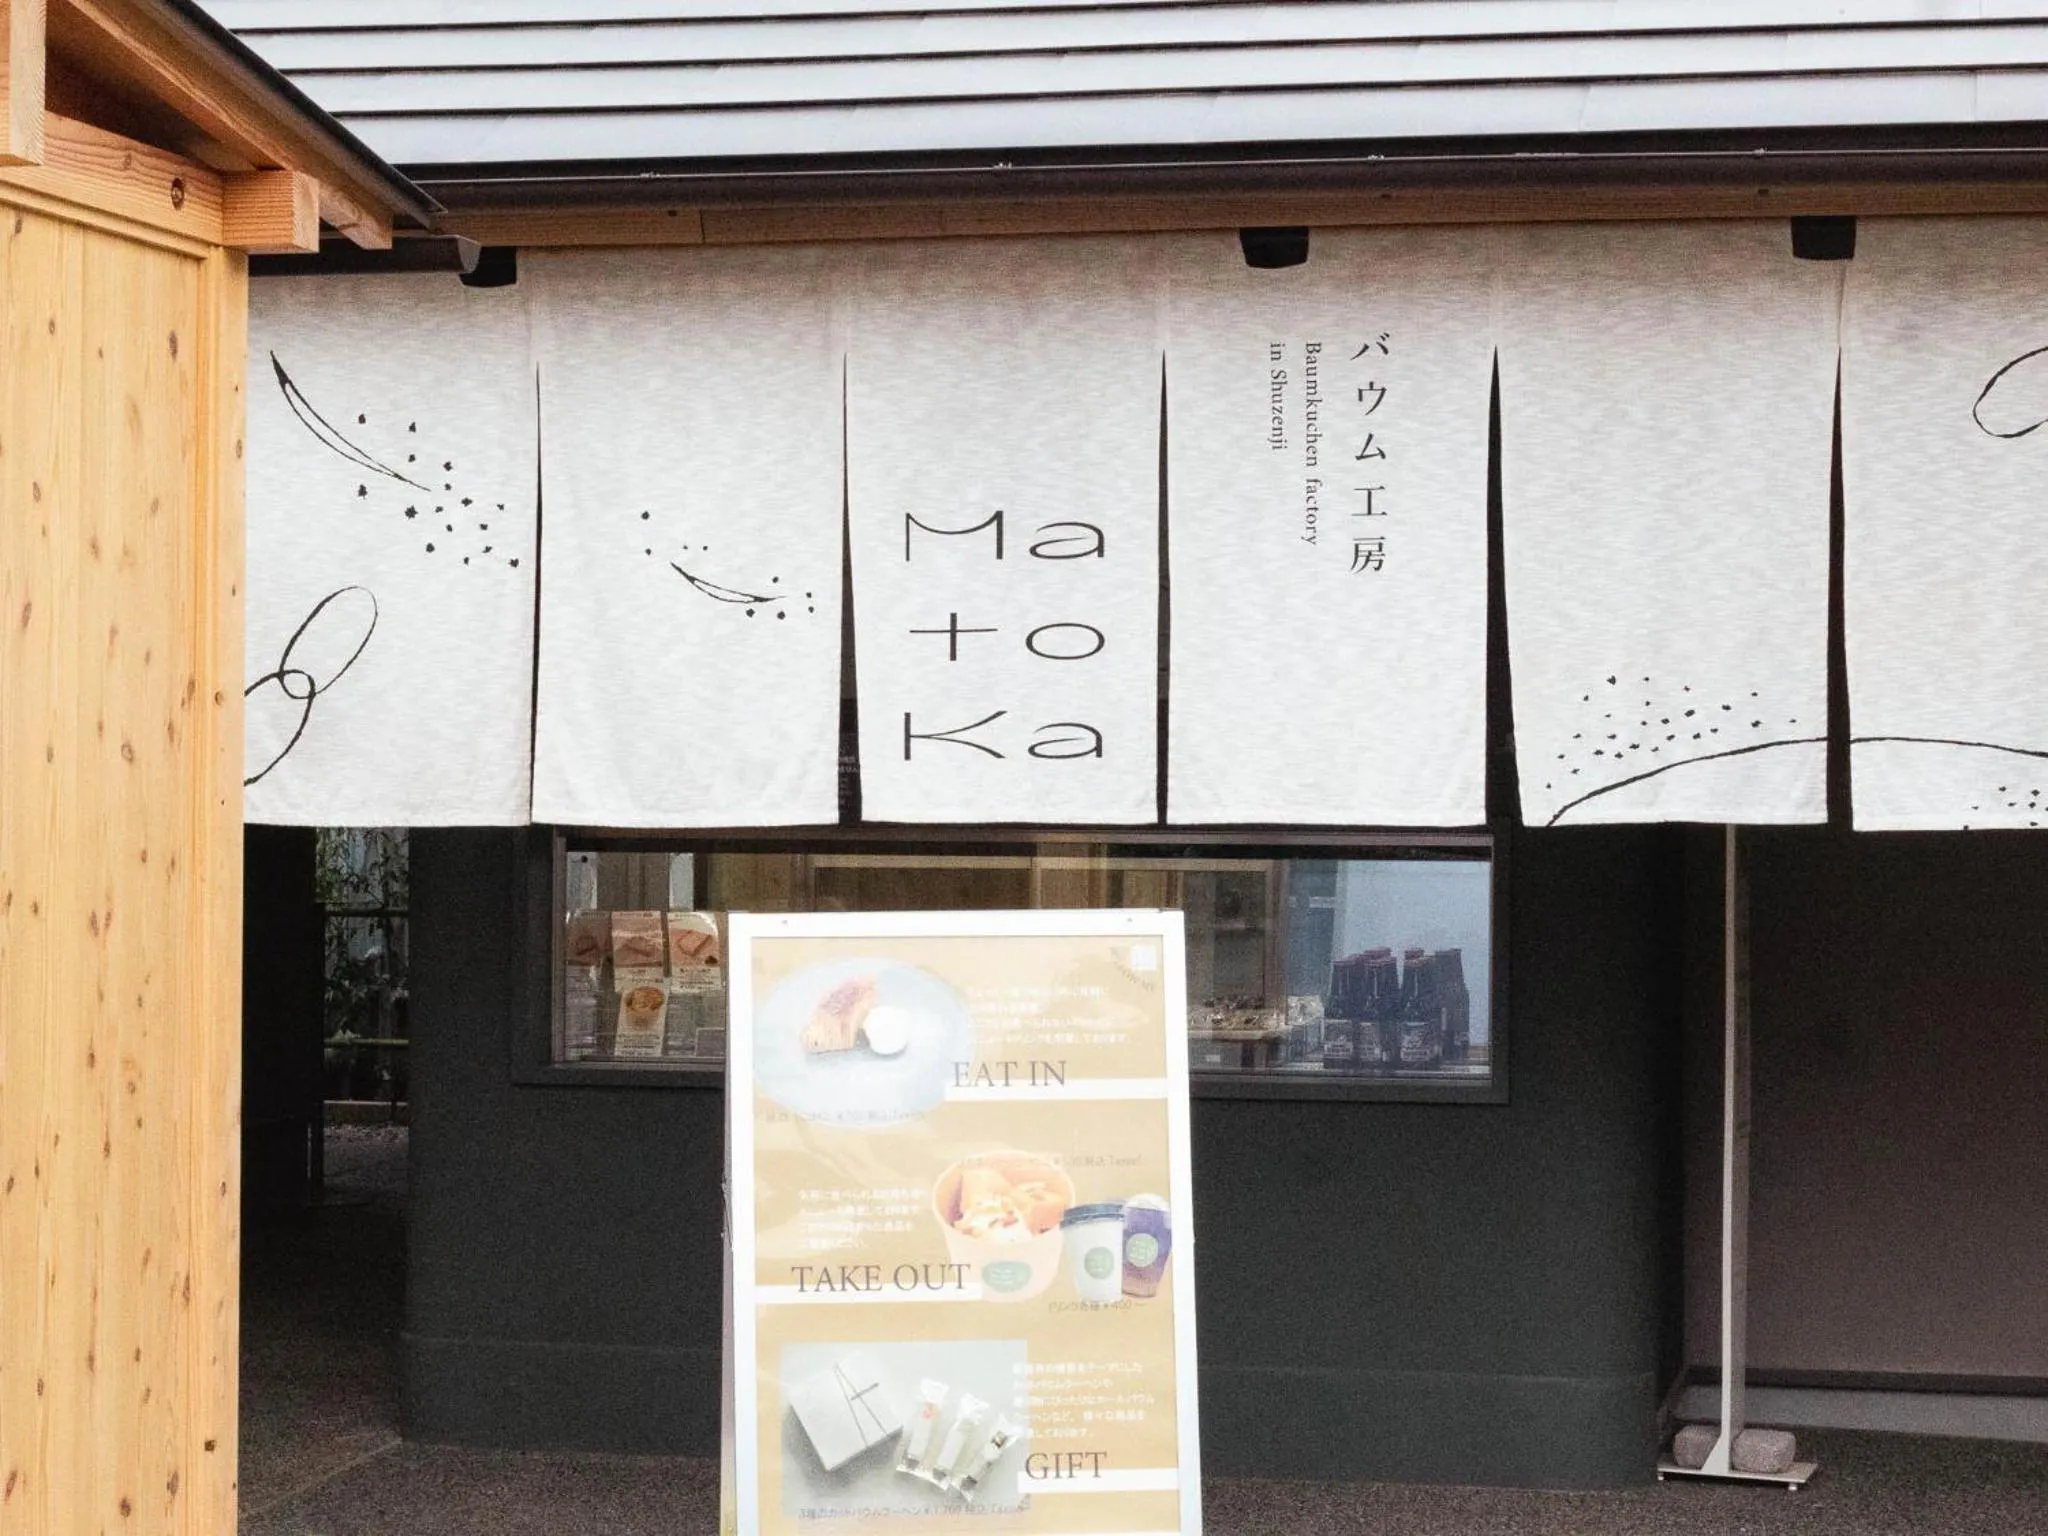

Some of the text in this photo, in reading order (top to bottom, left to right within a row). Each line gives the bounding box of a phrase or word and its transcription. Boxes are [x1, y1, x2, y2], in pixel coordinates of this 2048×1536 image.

[1267, 341, 1288, 451] in Shuzenji
[1300, 341, 1323, 546] Baumkuchen factory
[1350, 331, 1391, 574] バウム工房
[952, 1059, 1068, 1088] EAT IN
[791, 1265, 884, 1293] TAKE
[892, 1262, 972, 1291] OUT
[1025, 1450, 1108, 1480] GIFT
